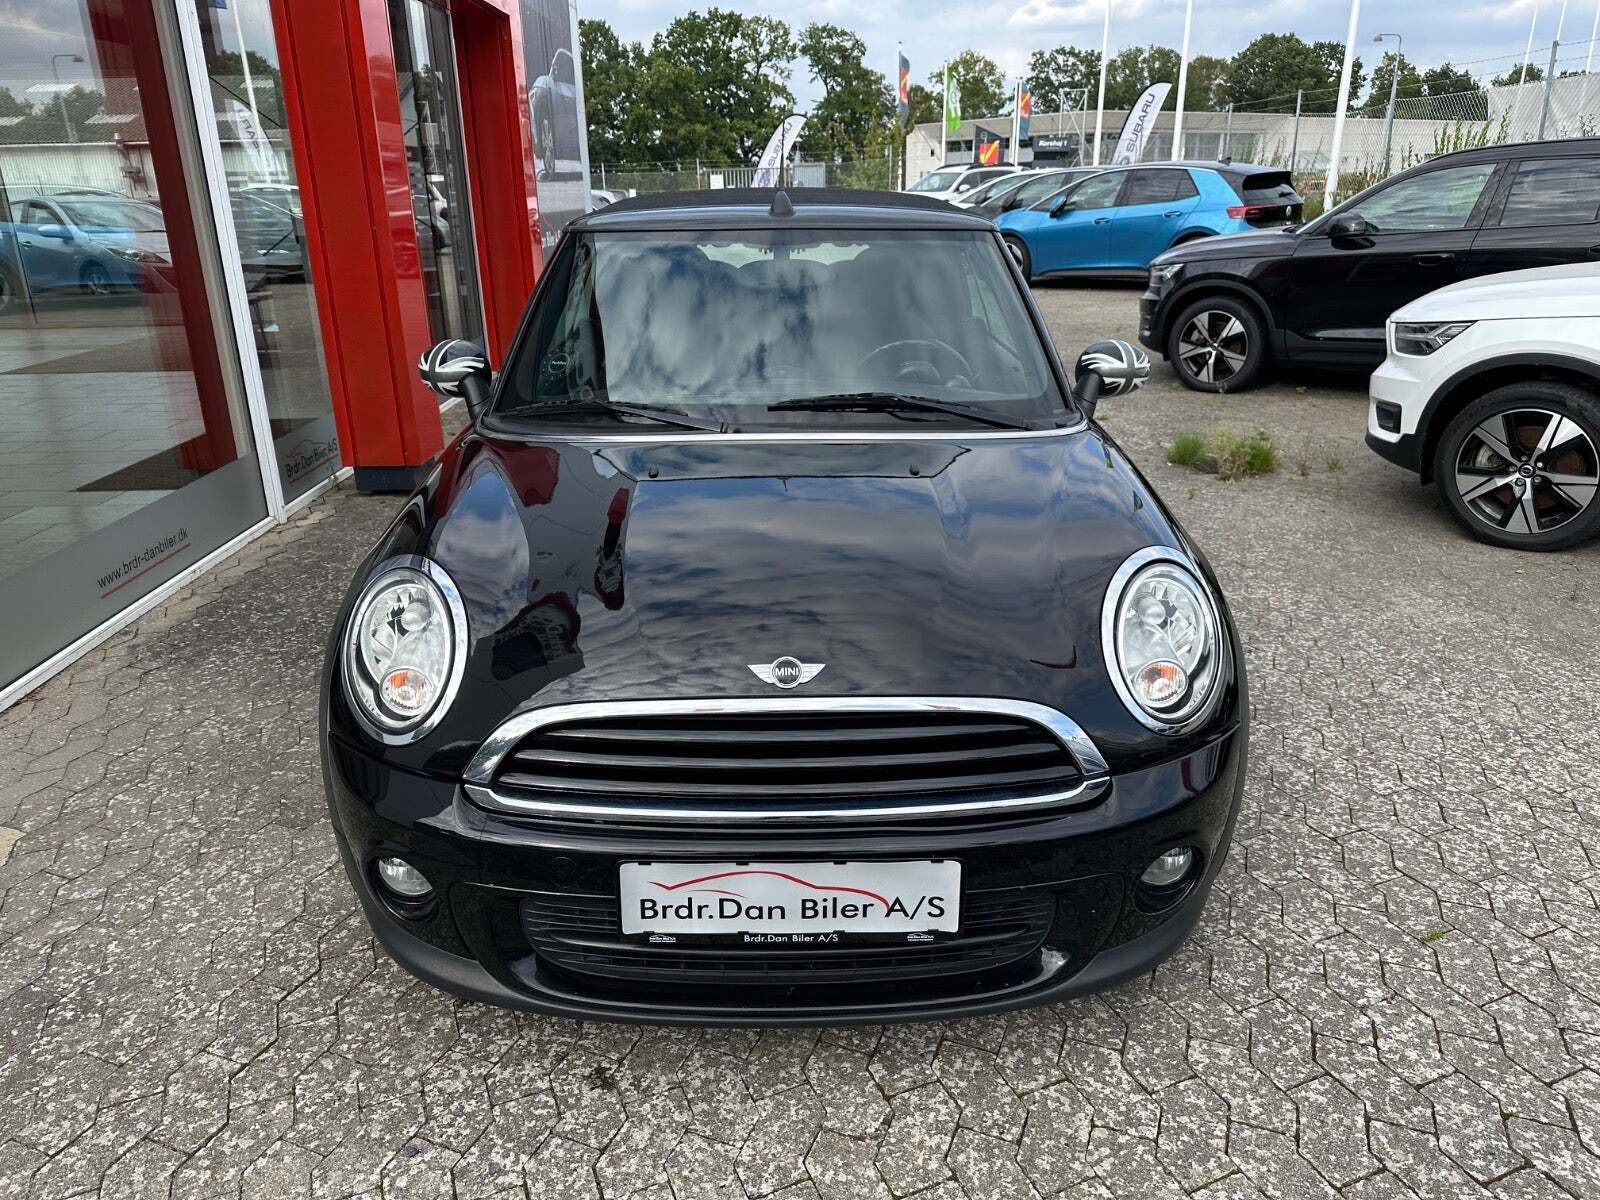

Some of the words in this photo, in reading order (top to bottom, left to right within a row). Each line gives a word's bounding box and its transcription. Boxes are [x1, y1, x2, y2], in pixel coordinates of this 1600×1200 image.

[1126, 93, 1155, 153] SUBARU
[98, 528, 189, 588] www.brdr-danbiler.dk
[775, 667, 799, 676] MINI
[639, 898, 787, 920] Brdr.Dan
[801, 898, 874, 919] Biler
[885, 896, 946, 919] A/S
[744, 934, 788, 943] Brdr.Dan
[792, 934, 814, 943] Biler
[818, 933, 839, 943] A/S
